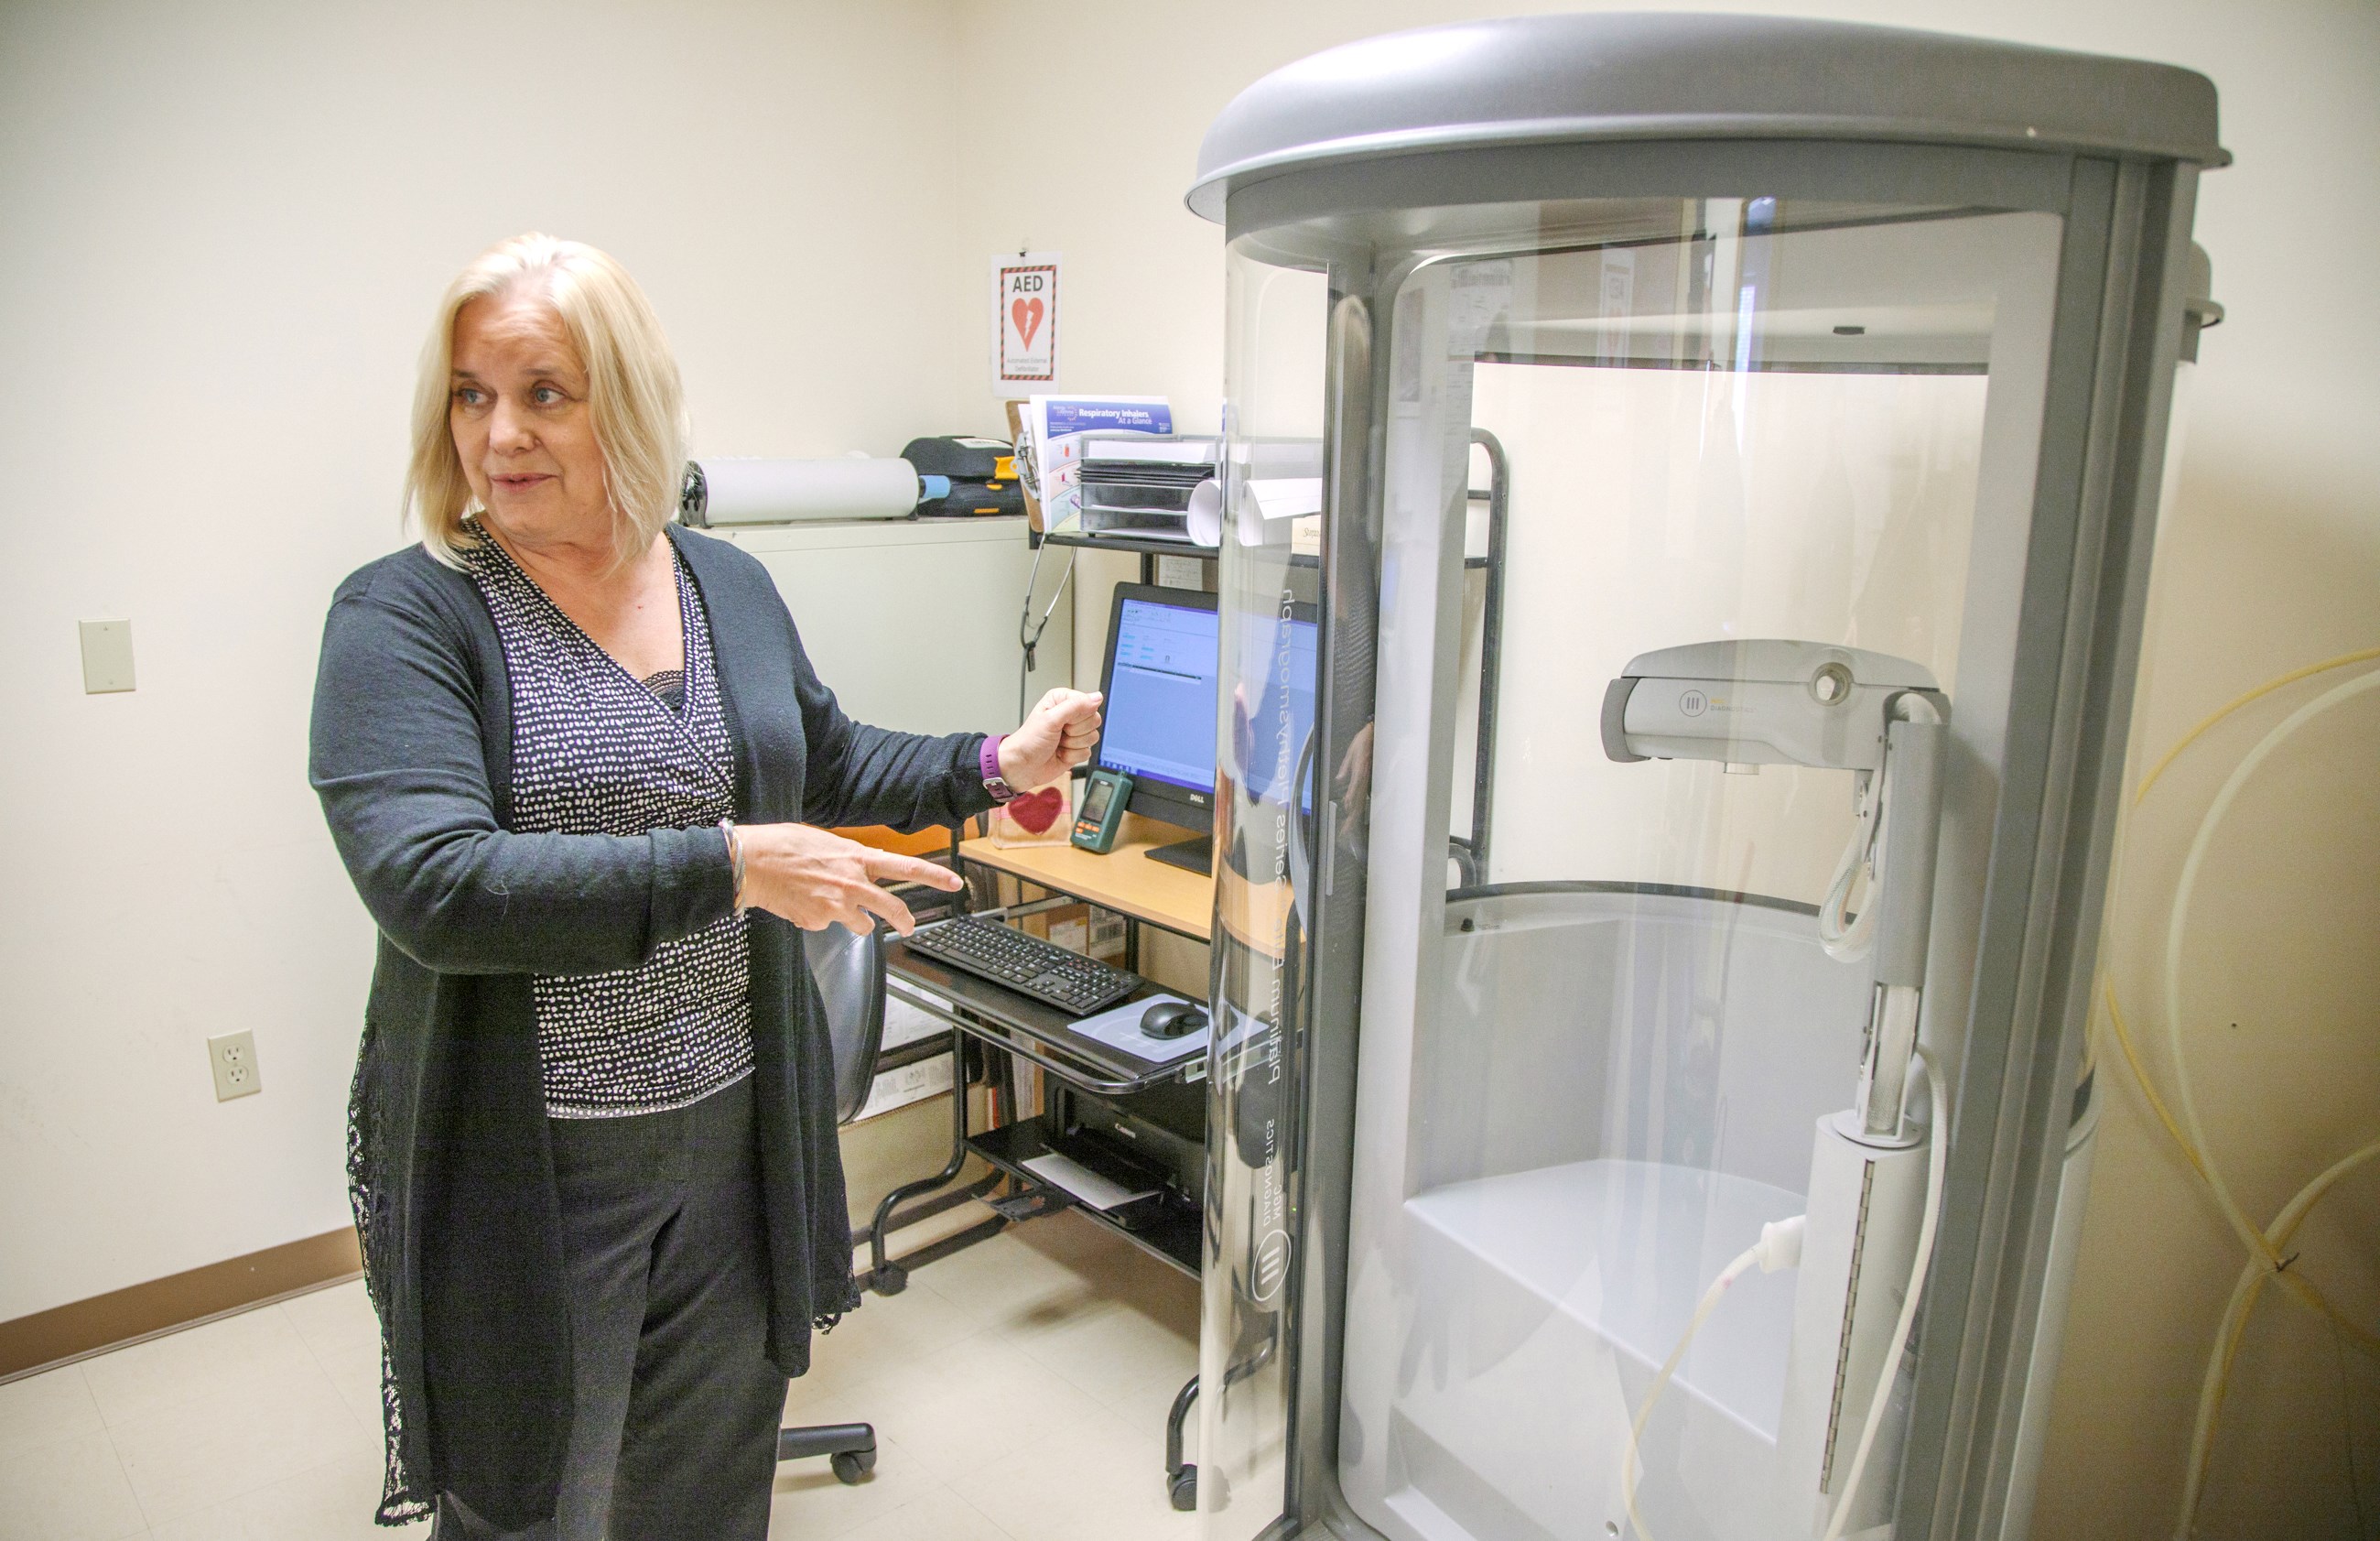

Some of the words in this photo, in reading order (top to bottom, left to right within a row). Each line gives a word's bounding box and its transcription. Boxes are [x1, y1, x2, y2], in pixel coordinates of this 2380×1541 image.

[1012, 276, 1044, 292] AED
[1079, 408, 1120, 418] Respiratory
[1190, 793, 1205, 803] DELL
